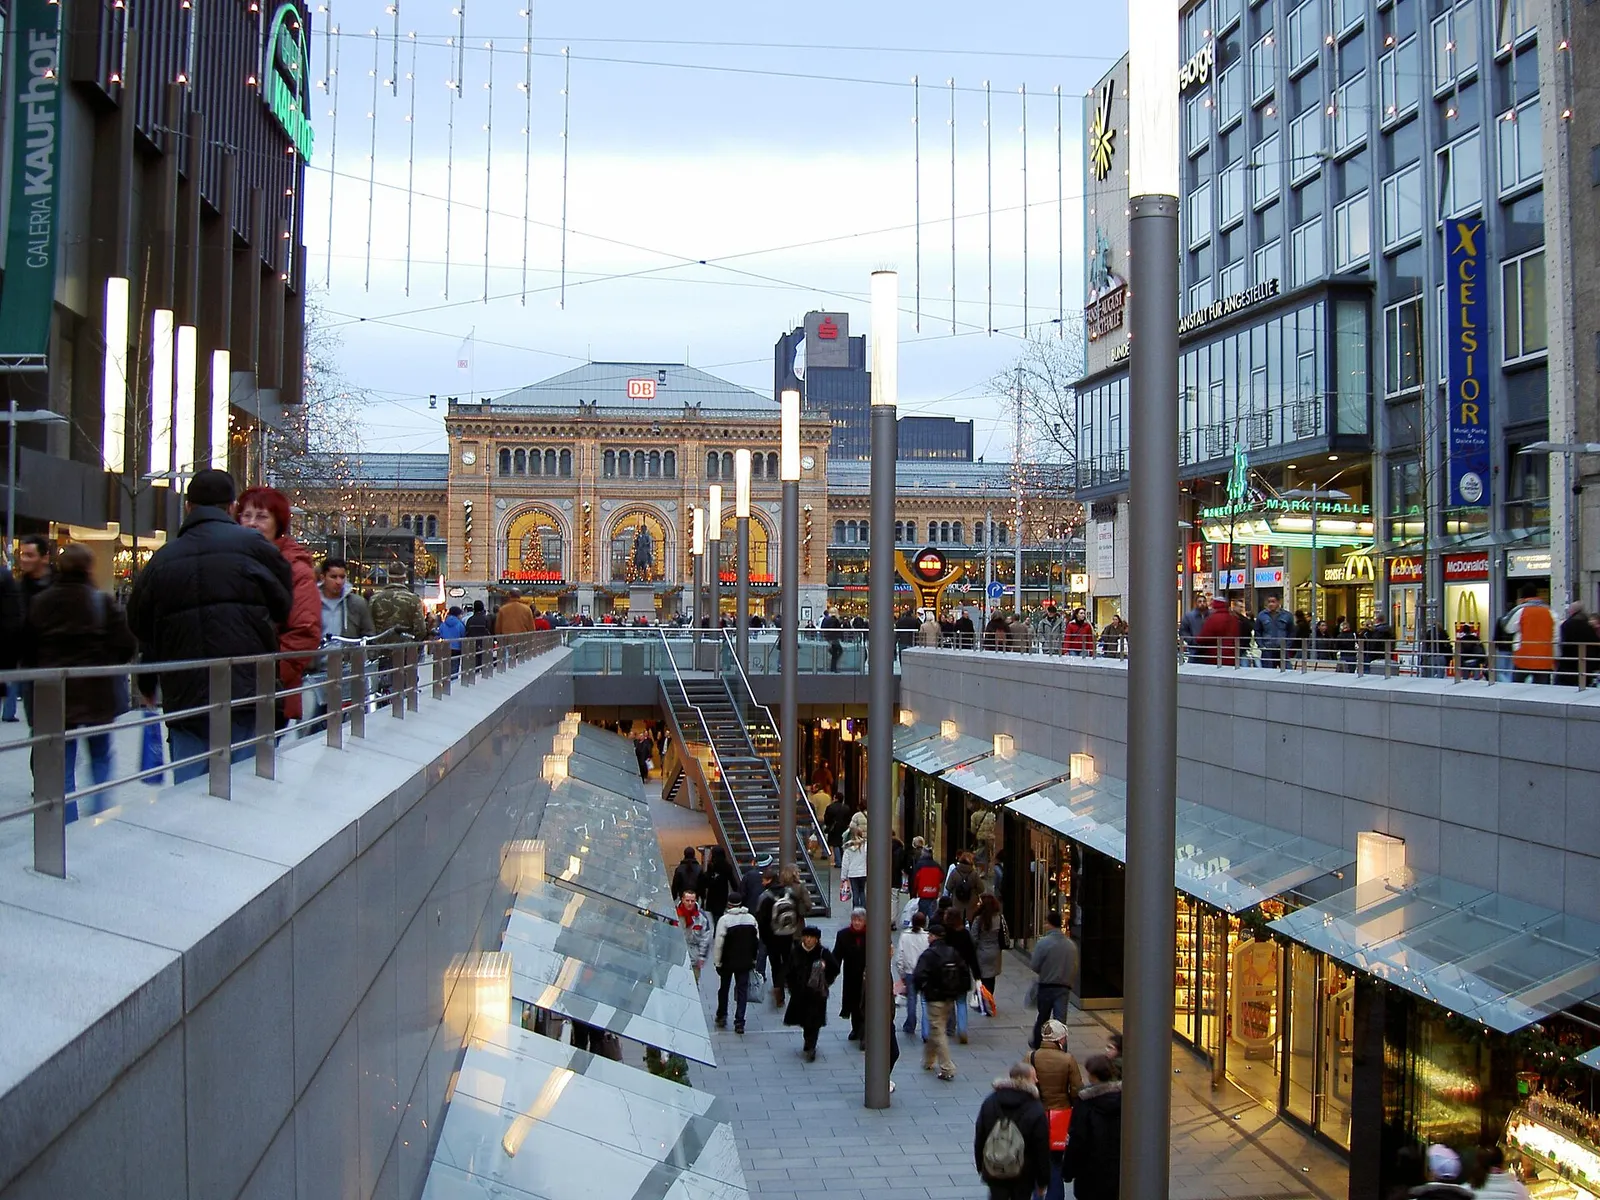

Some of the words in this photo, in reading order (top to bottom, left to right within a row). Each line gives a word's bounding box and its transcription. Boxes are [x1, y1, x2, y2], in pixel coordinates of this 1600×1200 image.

[1178, 40, 1213, 94] sorge
[27, 196, 52, 268] GALERIA
[1209, 299, 1222, 320] FÜR
[1224, 278, 1275, 314] ANGESTELLTE
[1452, 222, 1481, 425] XCELSIOR
[631, 382, 652, 396] DB
[1266, 498, 1371, 515] MARKTHALLE
[1446, 557, 1489, 573] McDonald's
